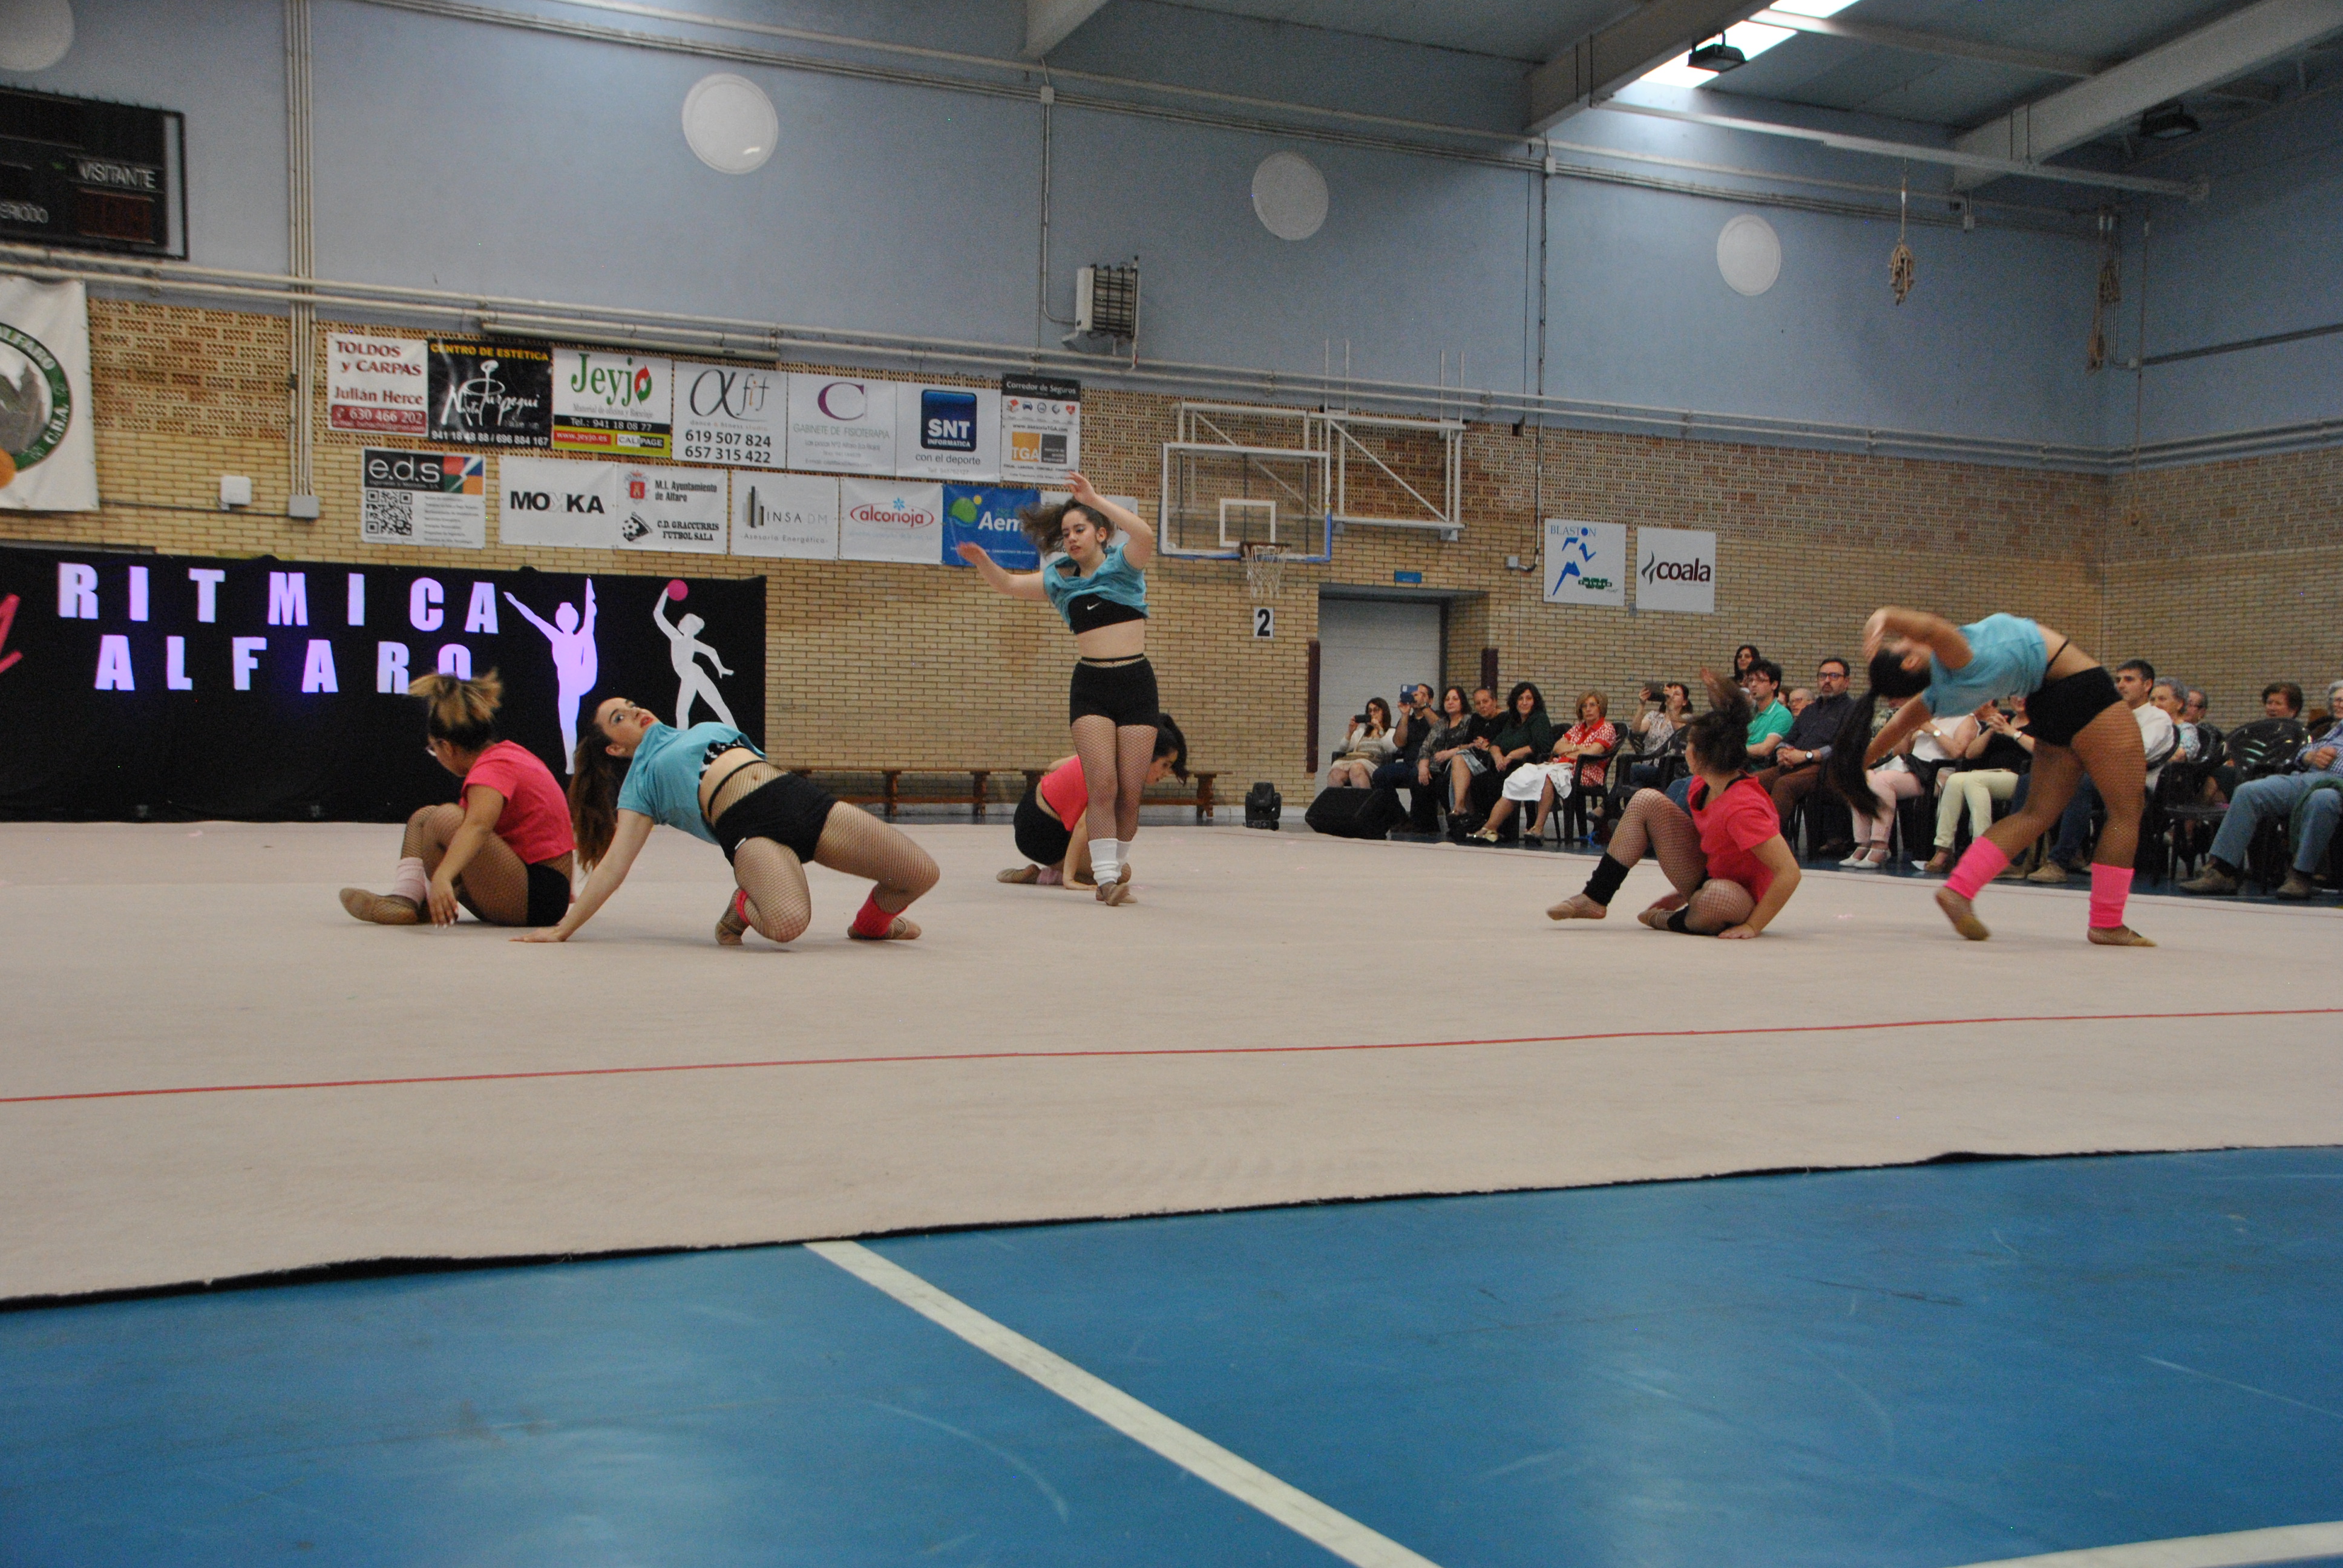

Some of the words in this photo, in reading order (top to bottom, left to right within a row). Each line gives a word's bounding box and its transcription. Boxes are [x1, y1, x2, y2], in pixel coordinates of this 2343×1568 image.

[79, 162, 156, 189] VISITANTE
[337, 341, 401, 358] TOLDOS
[430, 343, 476, 356] CENTRO
[479, 347, 494, 357] DE
[341, 362, 350, 373] y
[357, 360, 423, 376] CARPAS
[571, 353, 652, 407] Jeyjo
[1006, 381, 1038, 390] Corredor
[1050, 385, 1076, 395] Seguros
[383, 390, 424, 405] Herce
[818, 382, 864, 420] C
[349, 408, 372, 420] 630
[375, 410, 398, 423] 466
[401, 411, 423, 424] 202
[593, 419, 609, 429] 941
[614, 420, 624, 429] 18
[641, 423, 652, 431] 77
[793, 423, 828, 435] GABINETE
[831, 426, 841, 436] DE
[844, 427, 890, 439] FISIOTERAPIA
[928, 419, 970, 439] SNT
[431, 430, 448, 440] 941
[452, 431, 462, 440] 18
[496, 434, 513, 444] 696
[533, 437, 549, 446] 167
[557, 433, 608, 443] www.jeyjo.es
[686, 430, 712, 443] 619
[716, 431, 741, 445] 507
[746, 434, 771, 448] 824
[927, 439, 971, 448] INFORMATICA
[685, 446, 711, 459] 657
[716, 447, 741, 461] 315
[746, 450, 771, 463] 422
[946, 455, 980, 465] deporte
[1012, 447, 1039, 460] TGA
[369, 456, 440, 483] e.d.s
[672, 481, 717, 492] Ayuntamiento
[655, 492, 663, 501] de
[666, 492, 687, 502] Alfaro
[767, 511, 802, 523] INSA
[807, 513, 828, 524] DM
[672, 521, 719, 531] GRACCURRIS
[1550, 525, 1596, 537] BLASTON
[663, 531, 692, 540] FUTBOL
[1656, 558, 1711, 583] coala
[1257, 609, 1270, 636] 2
